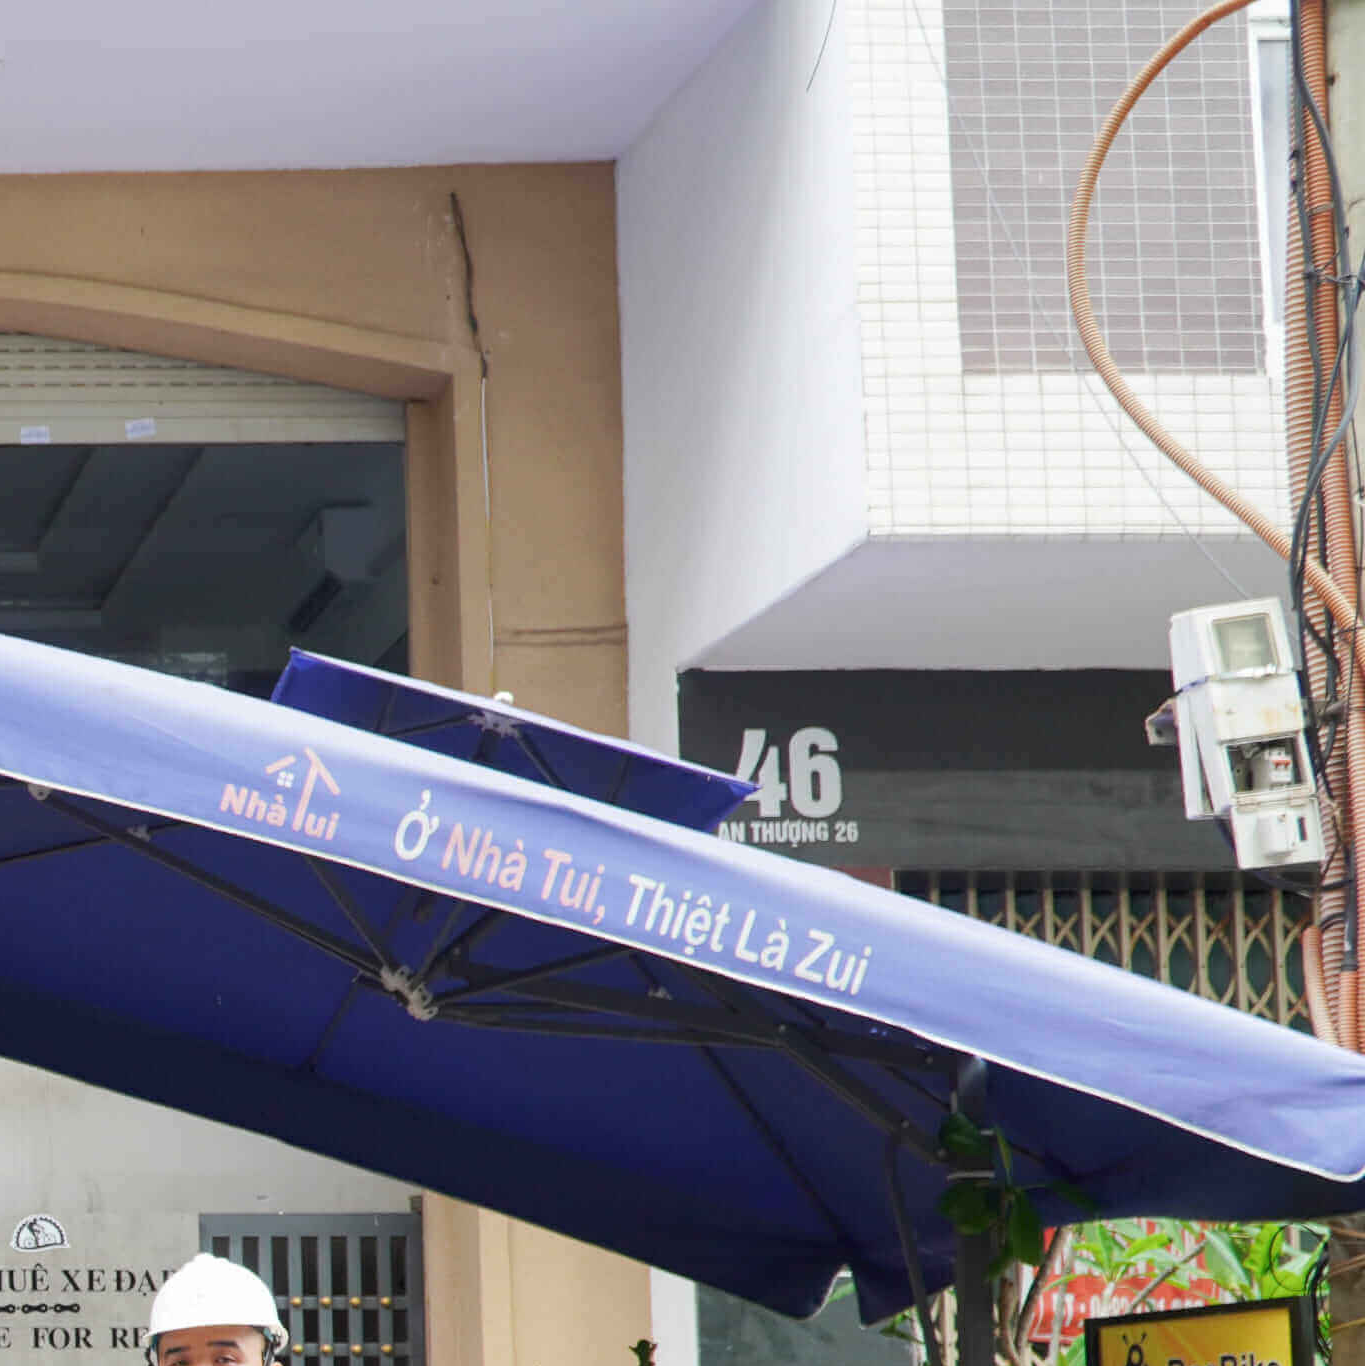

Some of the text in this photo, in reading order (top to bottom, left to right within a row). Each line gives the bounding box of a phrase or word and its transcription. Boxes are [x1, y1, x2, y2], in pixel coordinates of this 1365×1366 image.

[735, 726, 843, 818] 46
[220, 784, 287, 827] Nhà
[718, 820, 746, 842] AN
[834, 821, 859, 843] 26
[394, 789, 872, 996] Ở Nhà Tui, Thiệt Là Zui
[61, 1269, 106, 1292] XE
[33, 1327, 92, 1349] FOR
